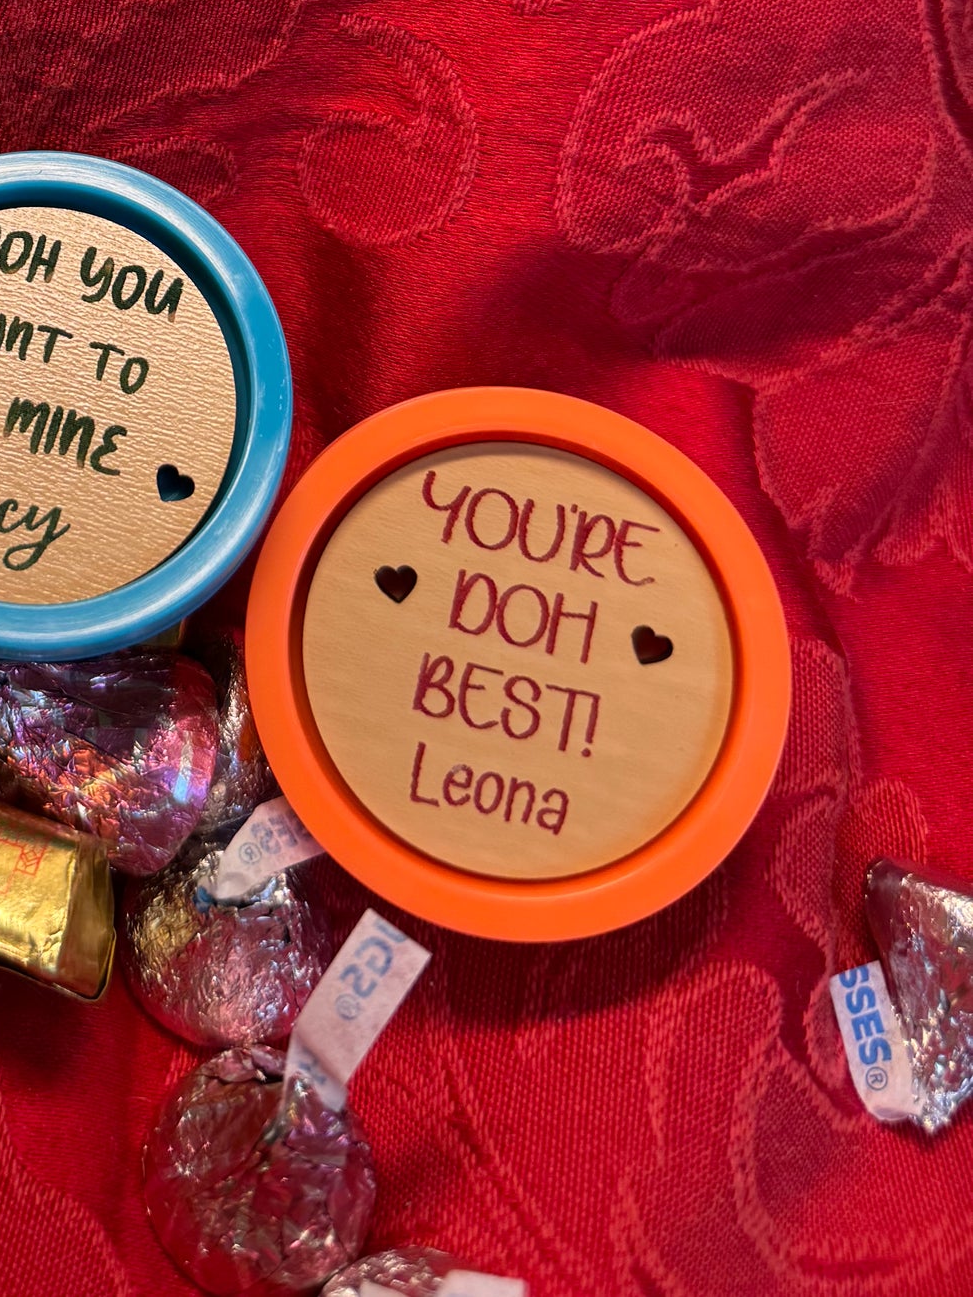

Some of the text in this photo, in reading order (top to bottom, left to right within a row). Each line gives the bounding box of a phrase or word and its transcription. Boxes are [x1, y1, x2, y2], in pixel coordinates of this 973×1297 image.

[80, 246, 184, 322] YOU
[90, 340, 149, 395] TO
[2, 394, 128, 476] MINE
[421, 470, 660, 587] YOU'RE
[448, 568, 598, 664] DOH
[412, 651, 602, 758] BEST!
[409, 741, 569, 836] Leona
